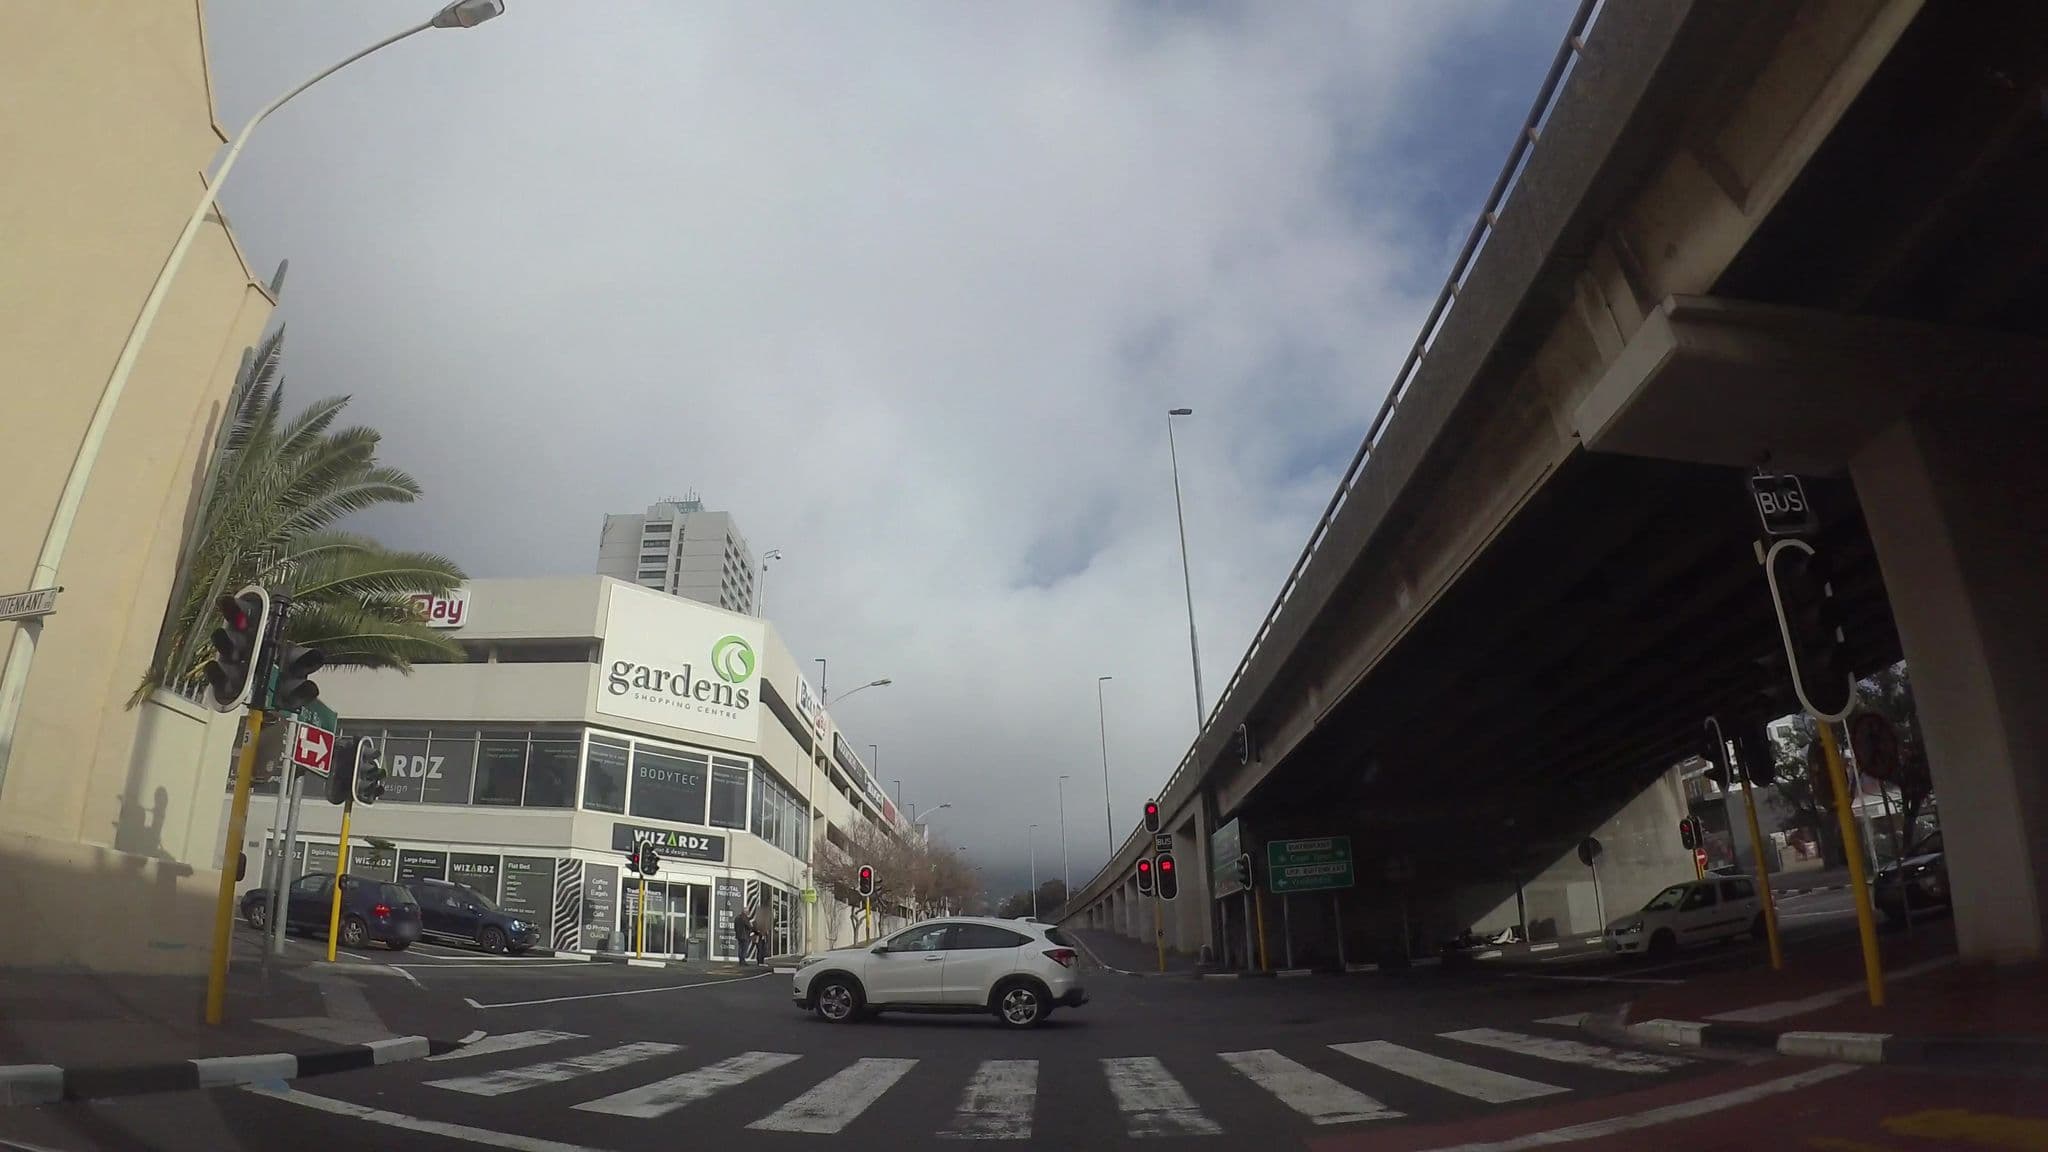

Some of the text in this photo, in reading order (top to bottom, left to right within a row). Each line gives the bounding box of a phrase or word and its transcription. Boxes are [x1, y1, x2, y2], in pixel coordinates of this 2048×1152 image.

[1759, 491, 1803, 514] BUS
[608, 660, 750, 710] gardens
[634, 692, 737, 720] SHOPPING CENTRE
[640, 766, 696, 786] BODYTEC
[634, 829, 709, 850] WIZARDZ
[1156, 838, 1172, 846] BUS
[453, 863, 495, 874] WIZARDZ
